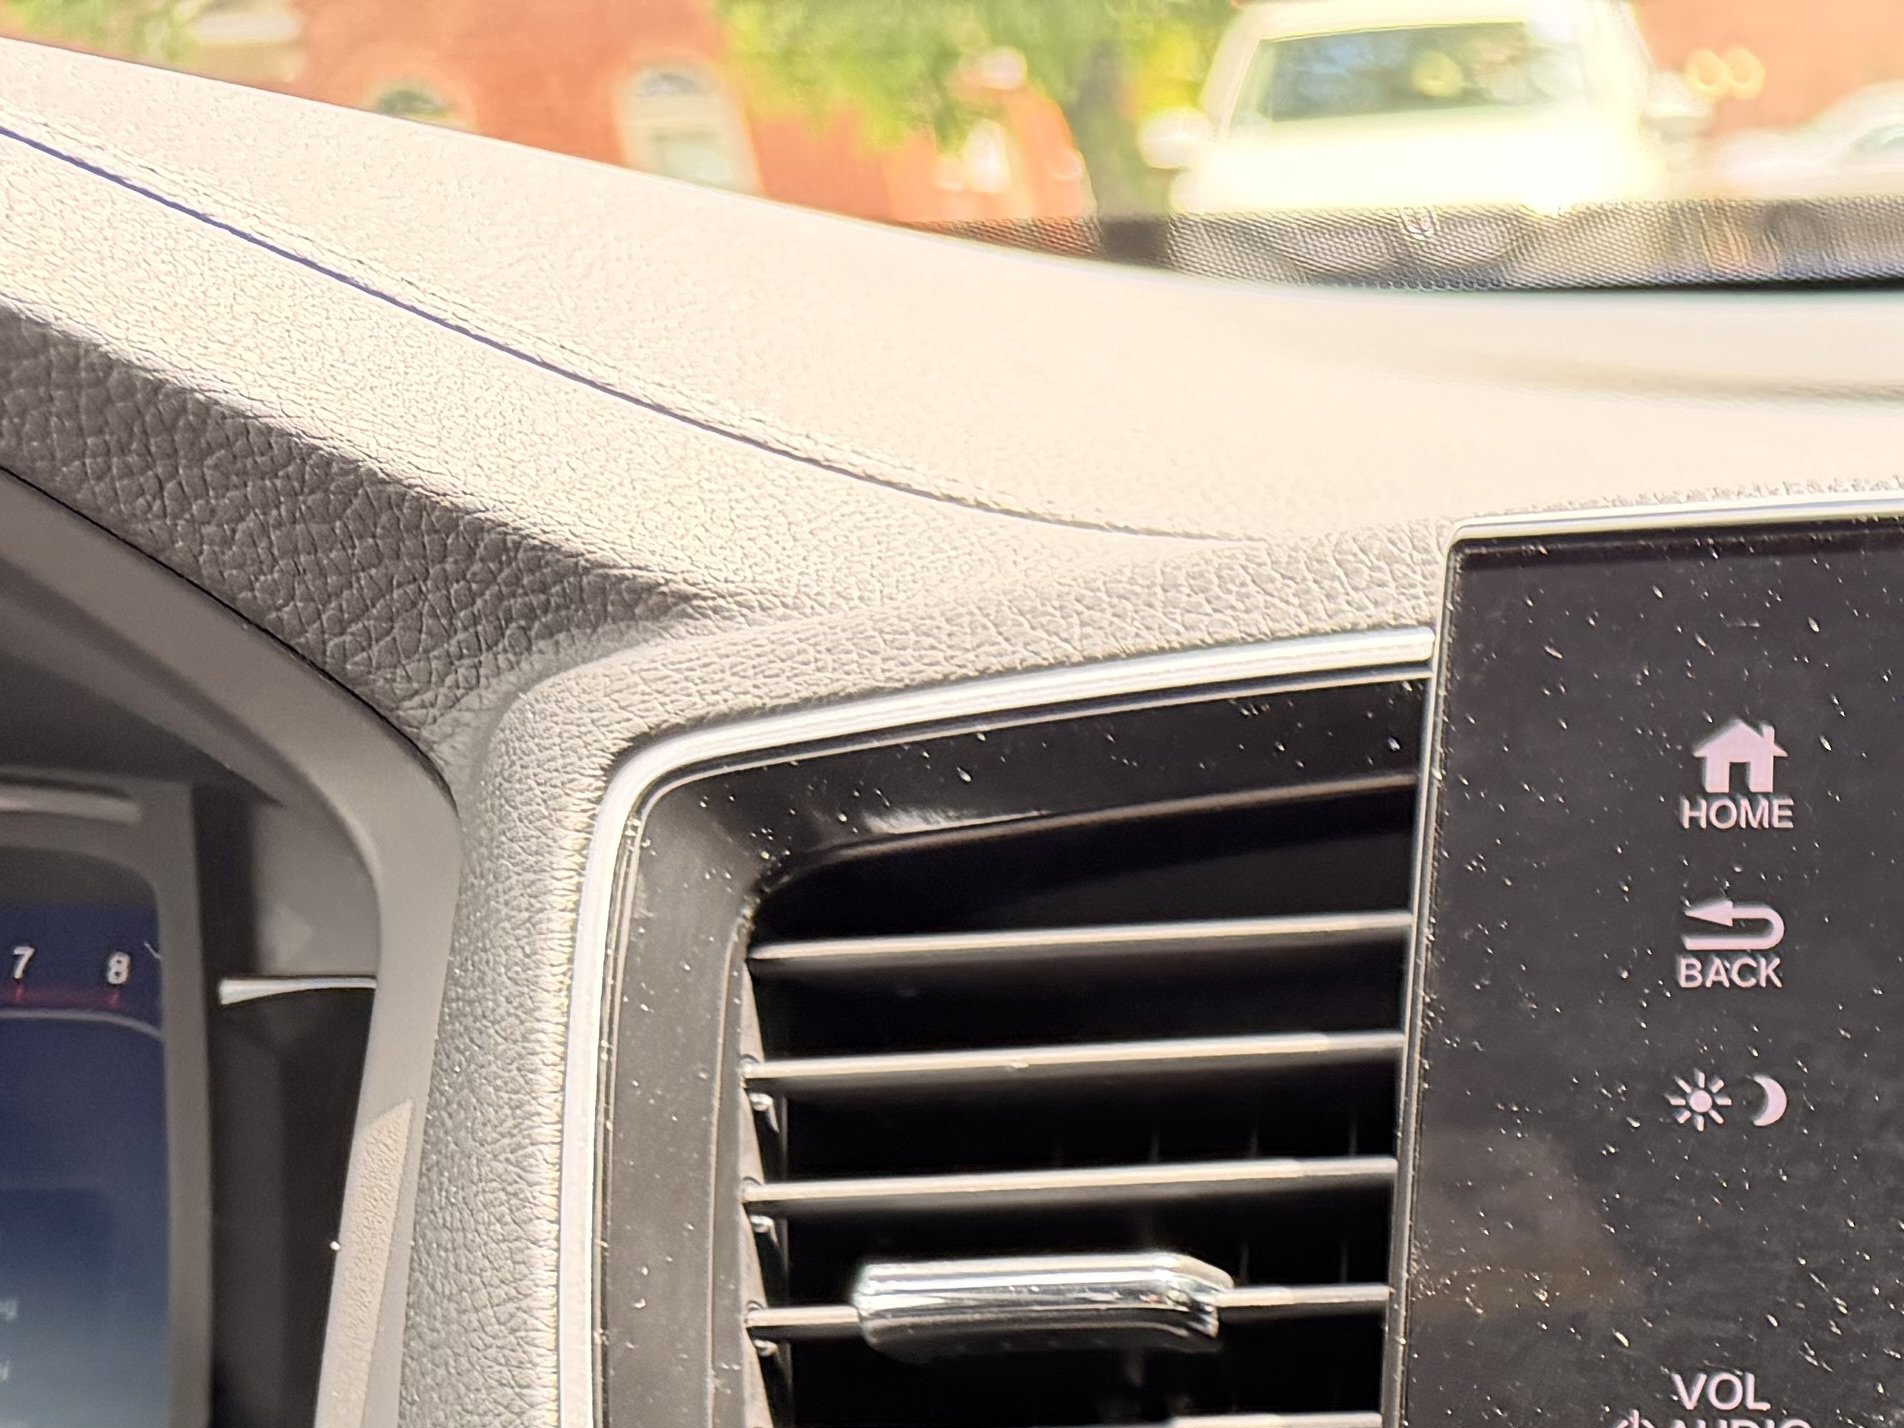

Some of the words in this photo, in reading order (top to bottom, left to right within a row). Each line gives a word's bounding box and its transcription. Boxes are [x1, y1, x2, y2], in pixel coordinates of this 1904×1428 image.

[1680, 797, 1794, 830] HOME
[13, 946, 35, 979] 7
[107, 952, 131, 985] 8
[1679, 957, 1783, 989] BACK
[1672, 1373, 1771, 1411] VOL
